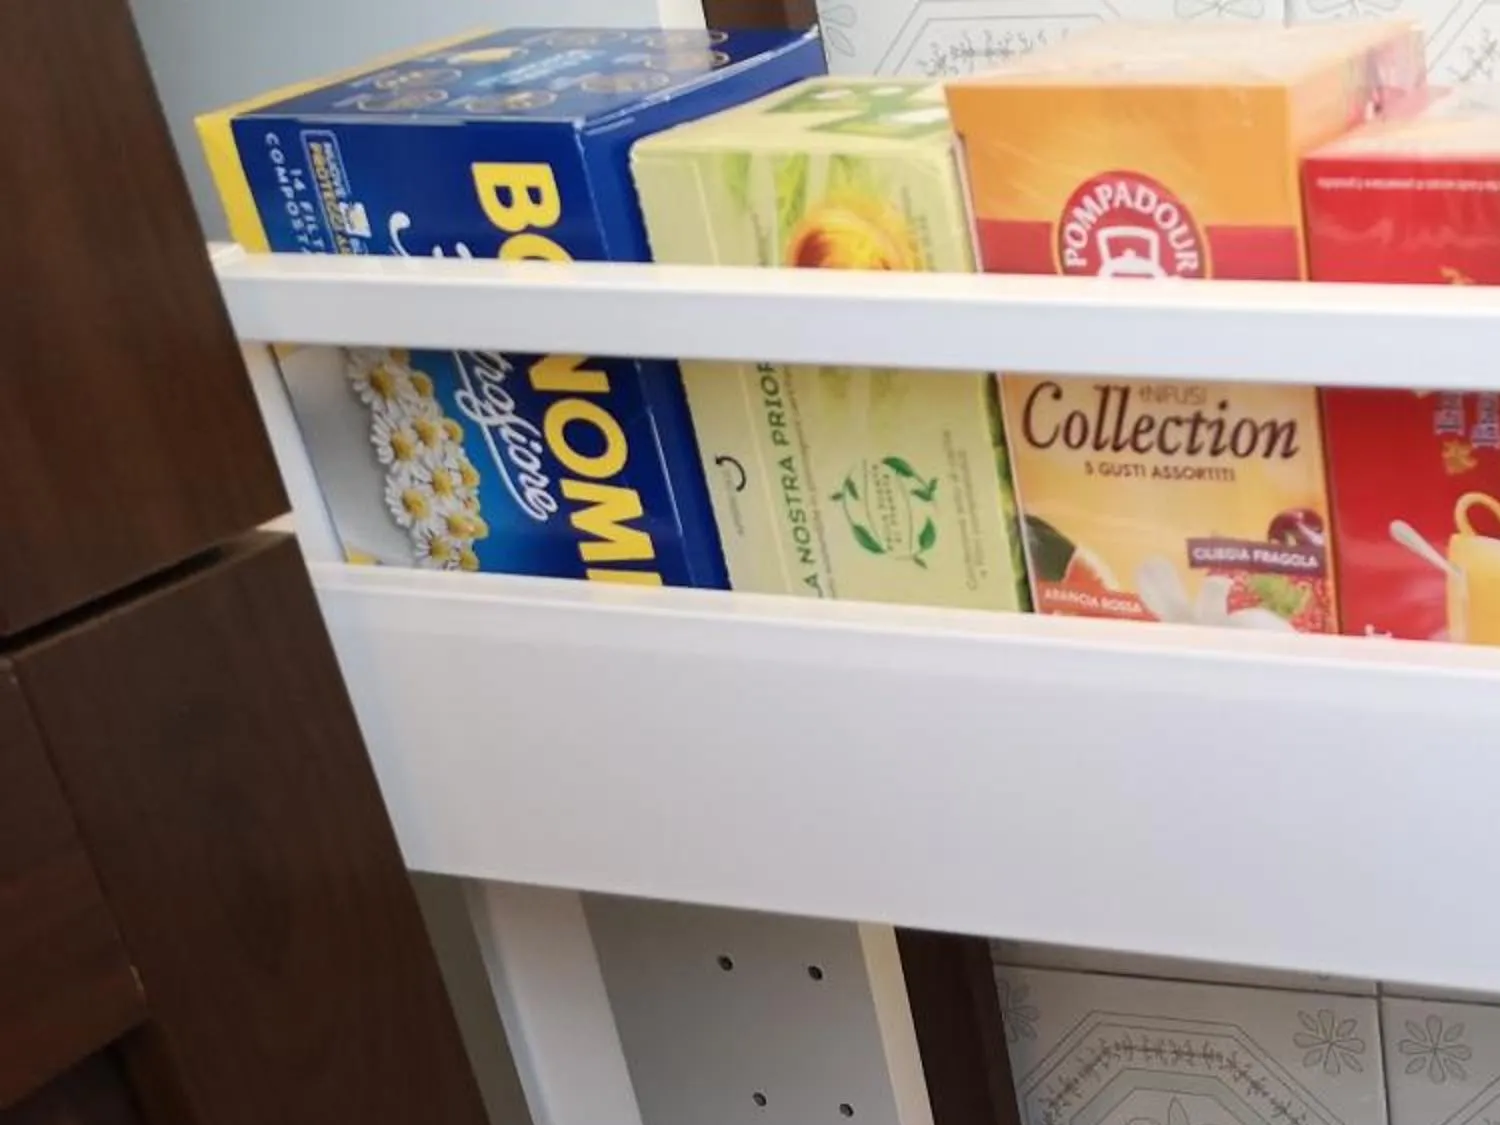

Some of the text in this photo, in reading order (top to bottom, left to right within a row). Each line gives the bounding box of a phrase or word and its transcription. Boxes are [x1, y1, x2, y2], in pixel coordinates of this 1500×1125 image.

[1065, 181, 1198, 271] POMPADOUR
[1022, 381, 1299, 459] Collection
[779, 455, 817, 564] NOSTRA
[1099, 462, 1146, 478] GUSTI
[1151, 464, 1235, 482] ASSORTITI
[1253, 549, 1318, 569] FRAGOLA
